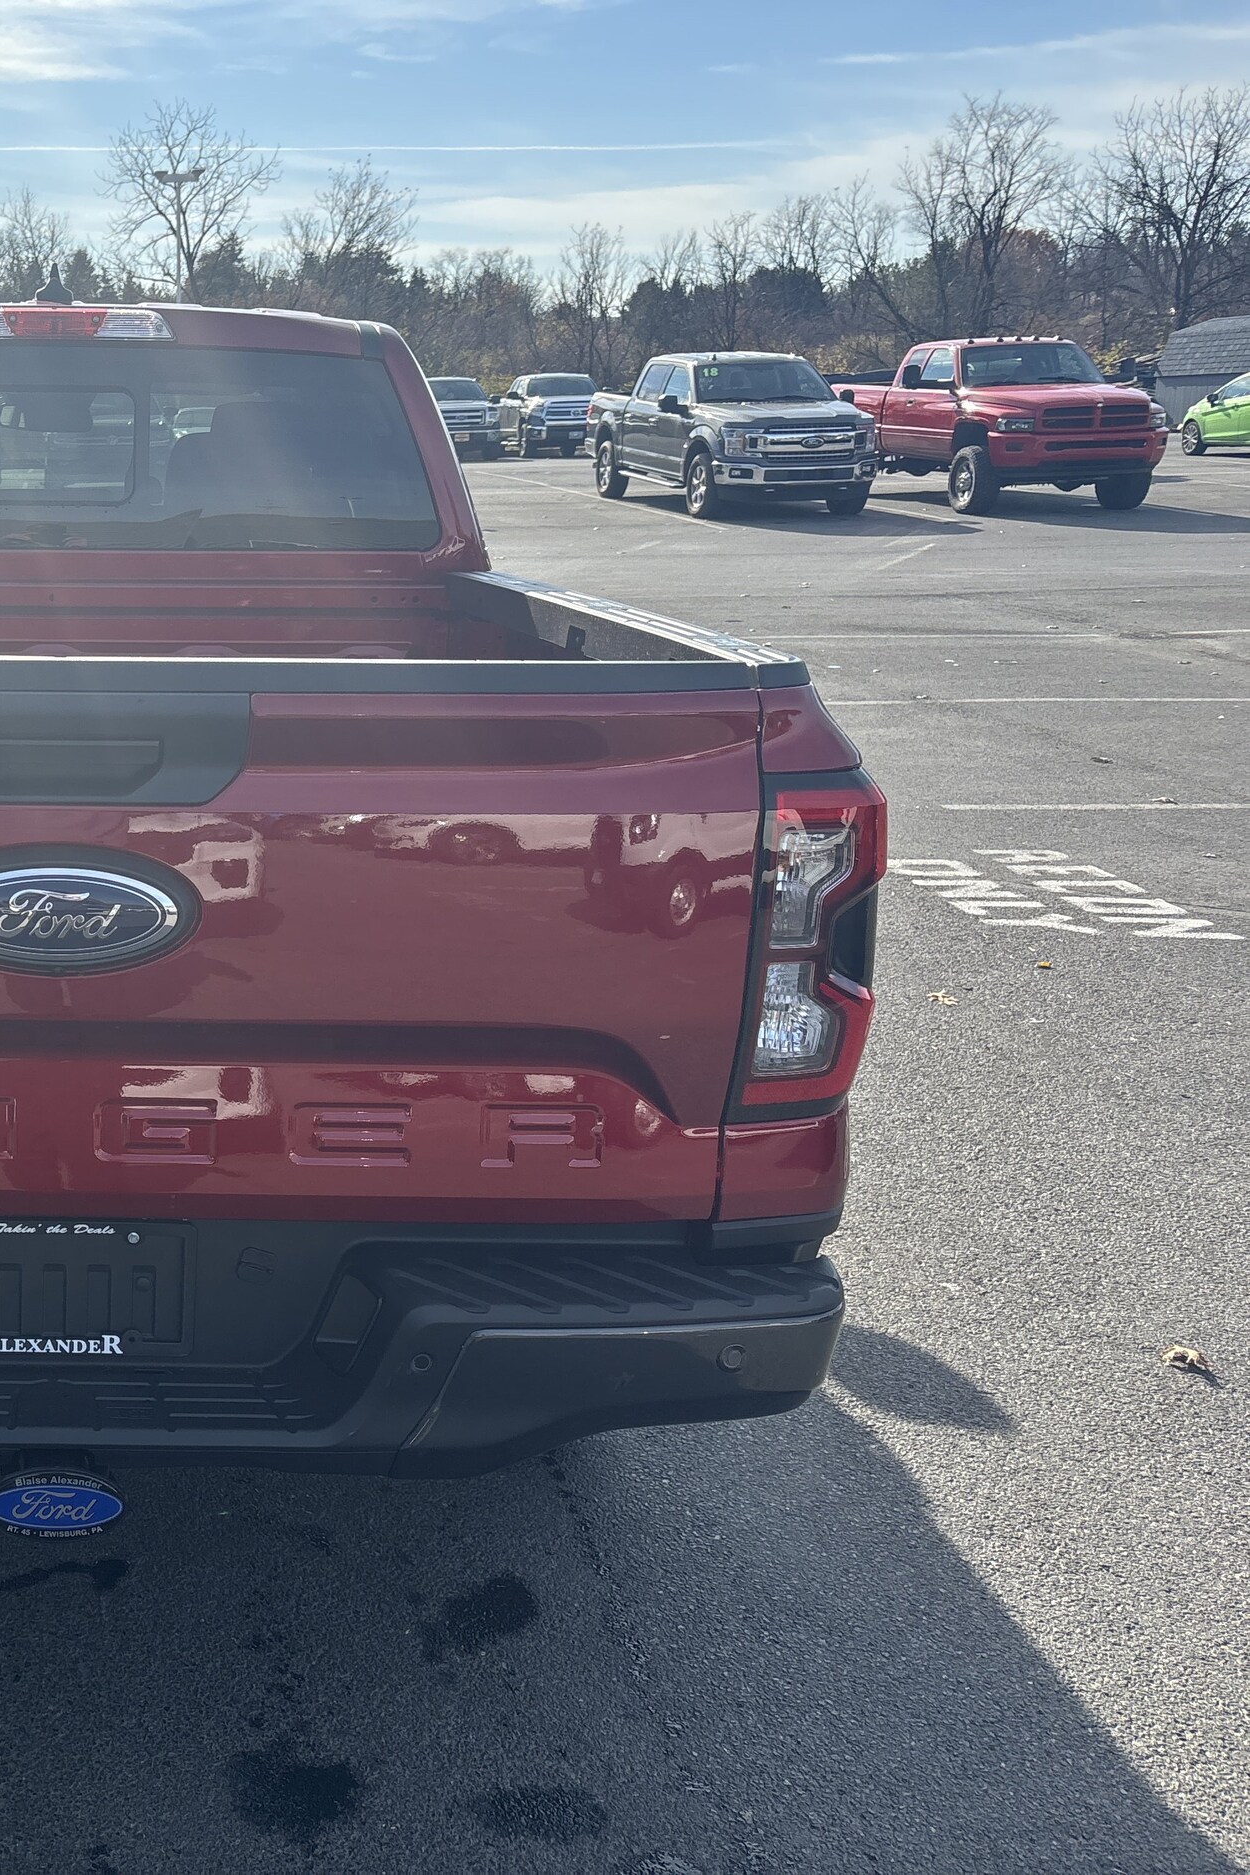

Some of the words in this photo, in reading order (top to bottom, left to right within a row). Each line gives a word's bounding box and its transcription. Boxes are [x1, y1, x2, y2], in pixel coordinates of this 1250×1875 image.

[702, 368, 719, 377] 18
[886, 858, 1107, 936] ONLY
[971, 848, 1247, 941] RECON
[45, 1223, 68, 1234] the
[73, 1223, 116, 1235] Deals
[14, 1476, 48, 1488] Blaise
[49, 1475, 103, 1490] Alexander
[11, 1489, 97, 1521] Ford
[6, 1524, 20, 1534] RT.
[91, 1526, 104, 1534] PA
